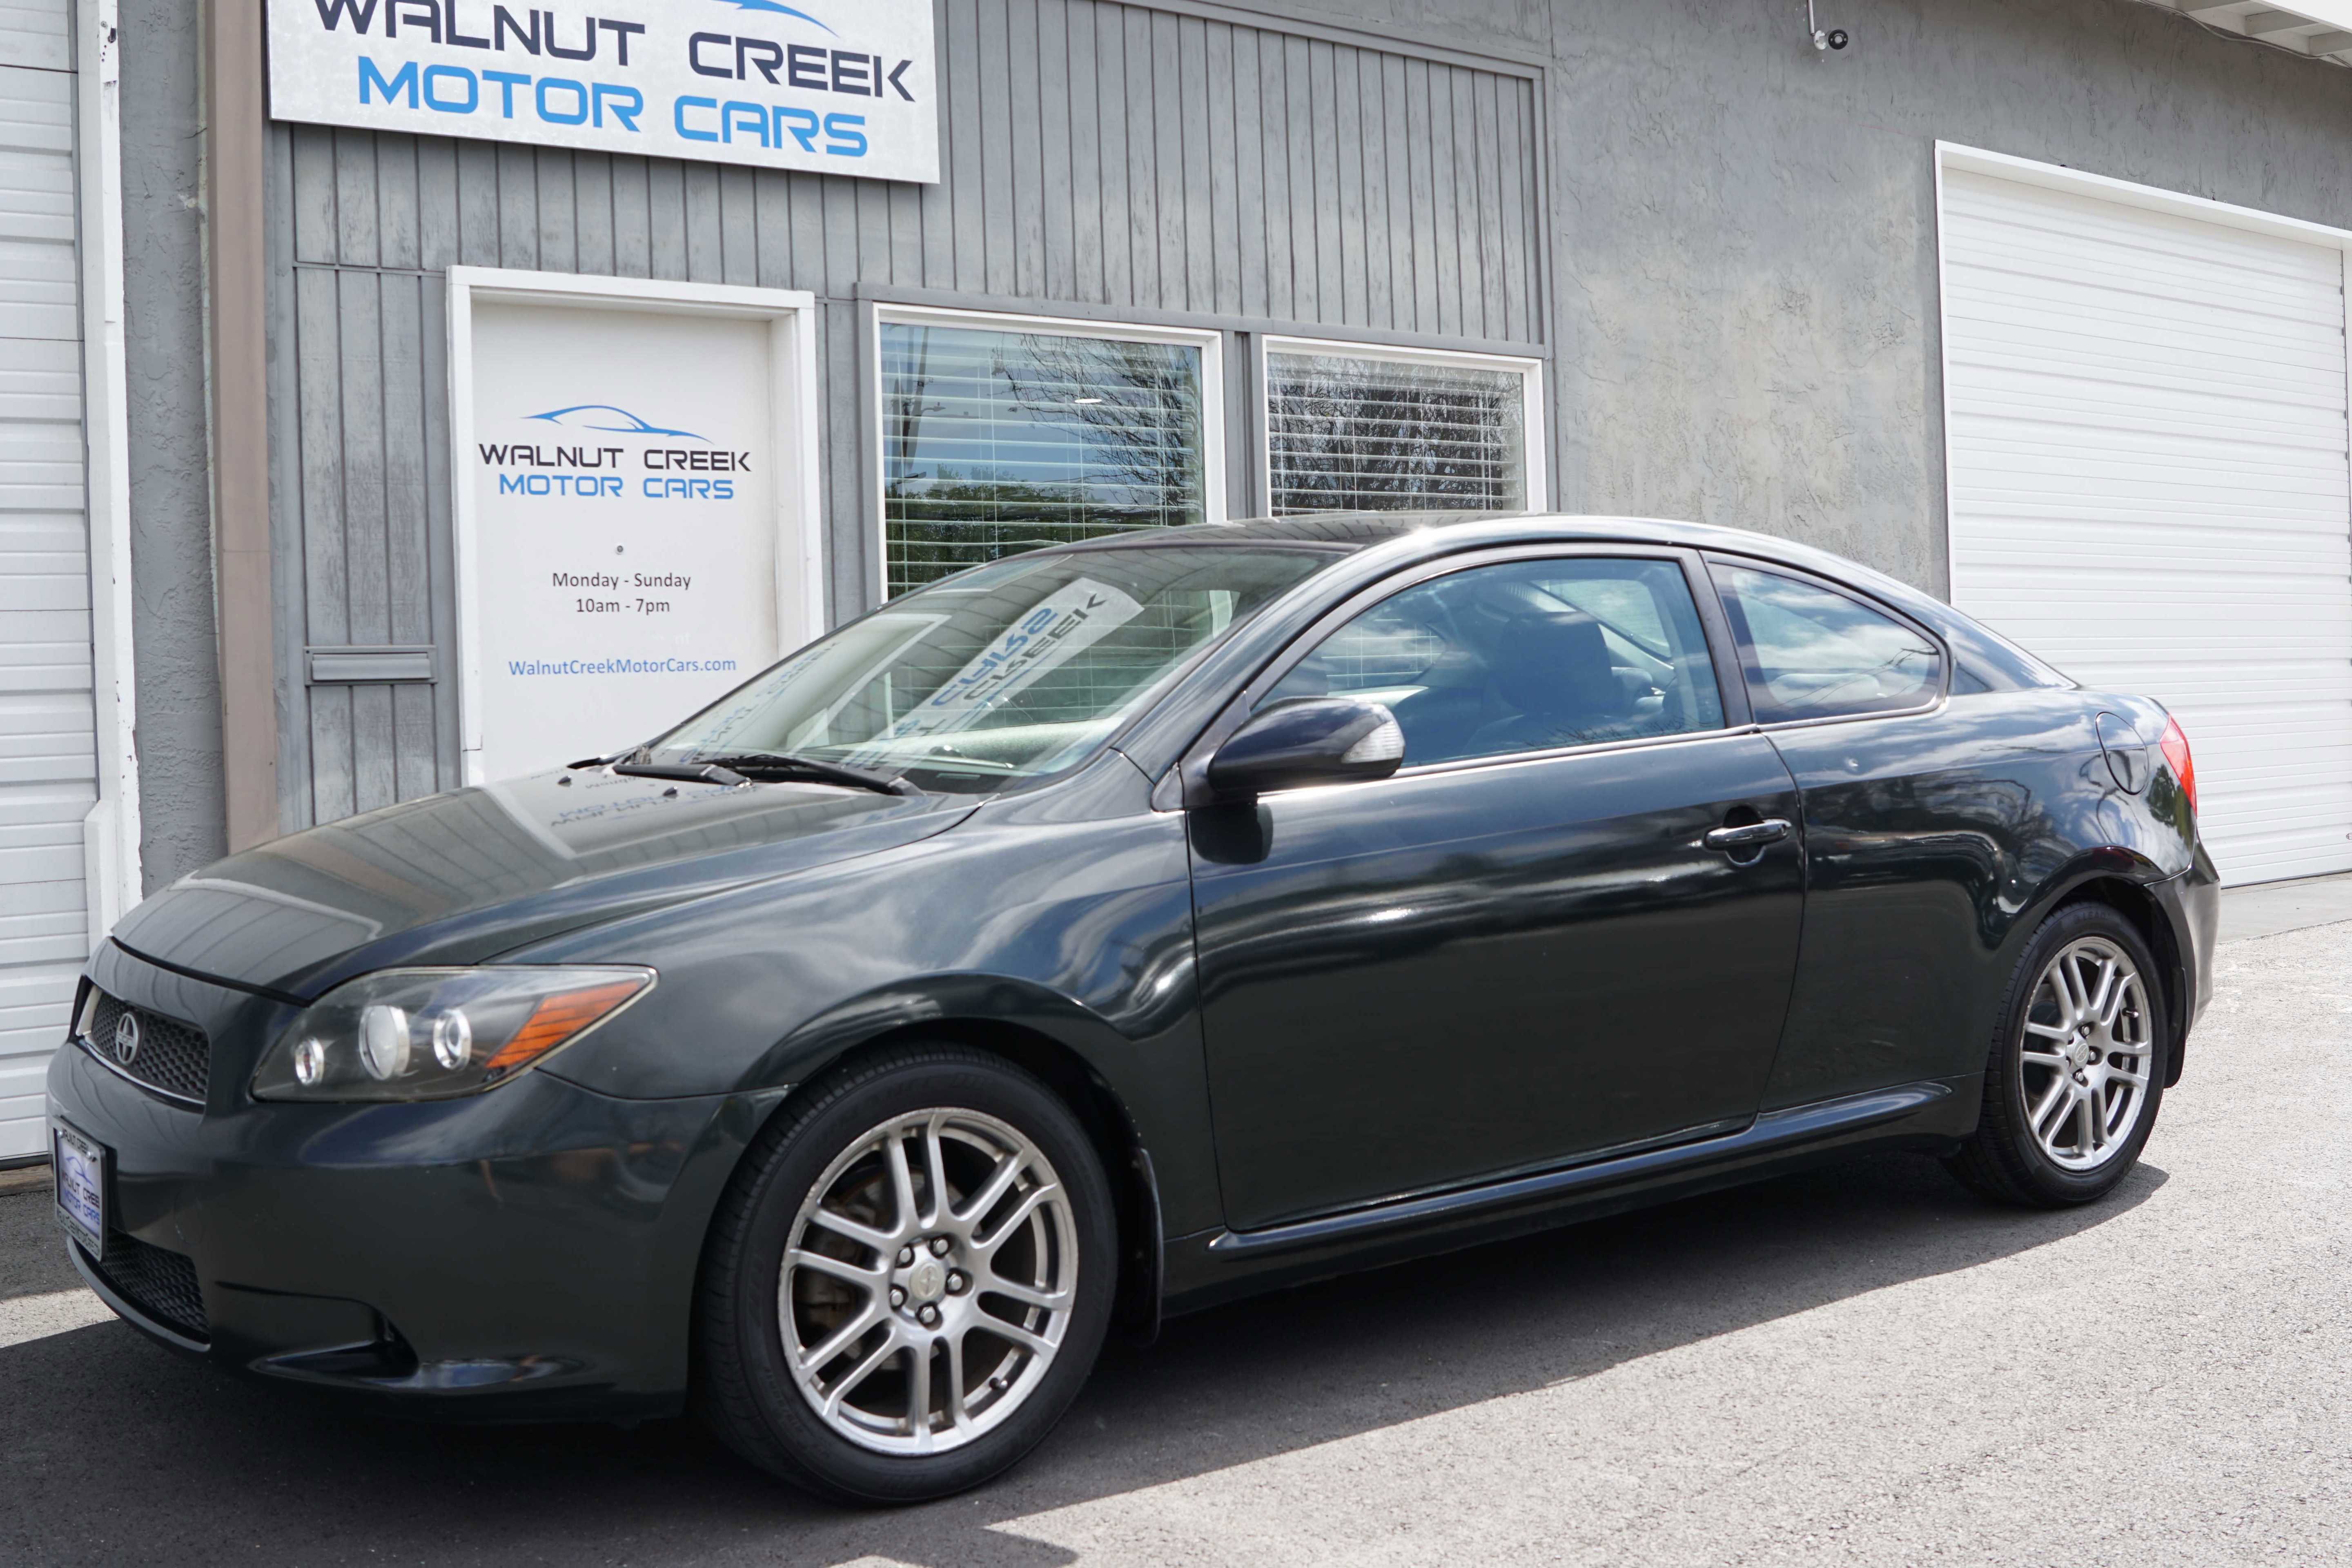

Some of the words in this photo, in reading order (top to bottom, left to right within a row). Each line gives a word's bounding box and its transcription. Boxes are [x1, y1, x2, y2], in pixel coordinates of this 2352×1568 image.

[314, 0, 645, 66] WALNUT
[689, 32, 915, 102] CREEK
[358, 56, 643, 132] MOTOR
[674, 95, 867, 157] CARS
[479, 443, 624, 468] WALNUT
[644, 449, 752, 472] CREEK
[499, 474, 623, 497] MOTOR
[643, 478, 733, 499] CARS
[552, 572, 619, 590] Monday
[634, 572, 691, 590] Sunday
[576, 599, 620, 612] 10am
[636, 599, 670, 615] 7pm
[509, 658, 736, 676] WalnutCreekMotorCars.com
